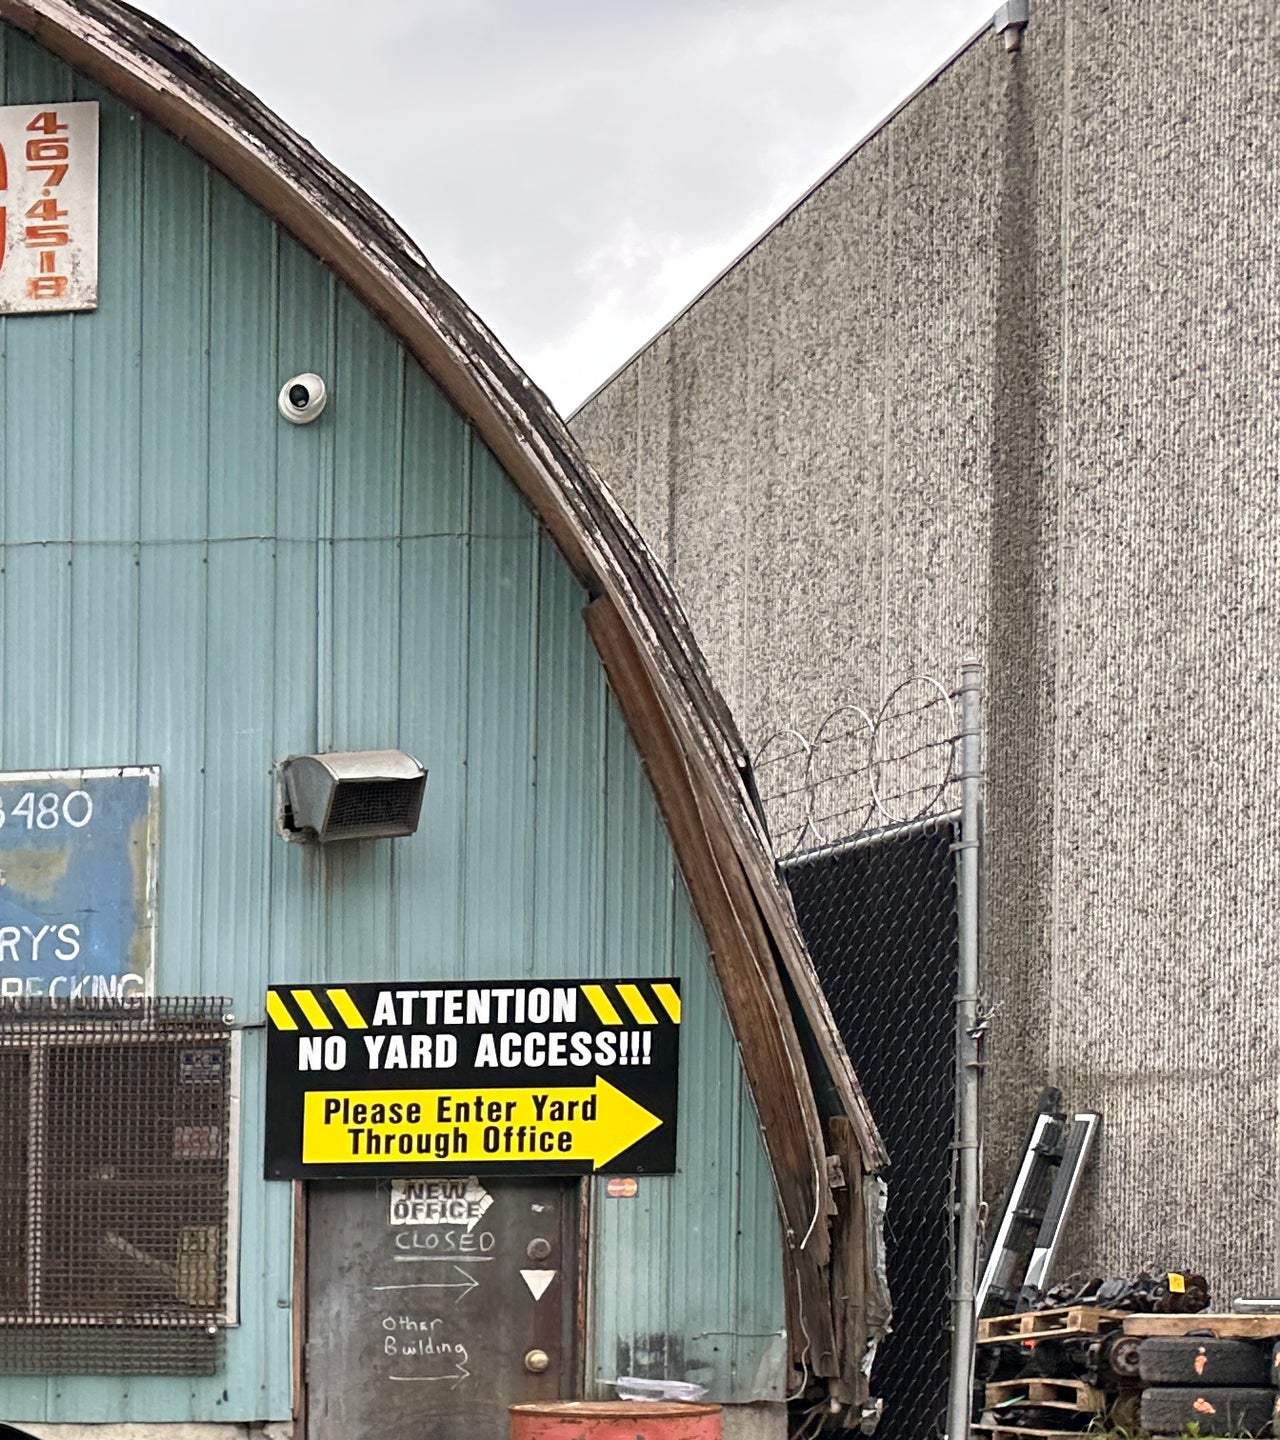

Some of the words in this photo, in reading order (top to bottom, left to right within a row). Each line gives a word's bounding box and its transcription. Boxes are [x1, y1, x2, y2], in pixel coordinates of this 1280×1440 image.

[372, 987, 577, 1027] ATTENTION
[298, 1035, 347, 1071] NO
[363, 1033, 457, 1069] YARD
[474, 1030, 652, 1068] ACCESS!!!
[323, 1096, 422, 1125] Please
[437, 1096, 517, 1124] Enter
[532, 1094, 598, 1121] Yard
[347, 1127, 468, 1158] Through
[483, 1125, 573, 1154] Office
[406, 1181, 468, 1199] NEW
[393, 1199, 481, 1220] OFFICE
[395, 1230, 496, 1252] CLOSED
[382, 1316, 443, 1332] Other
